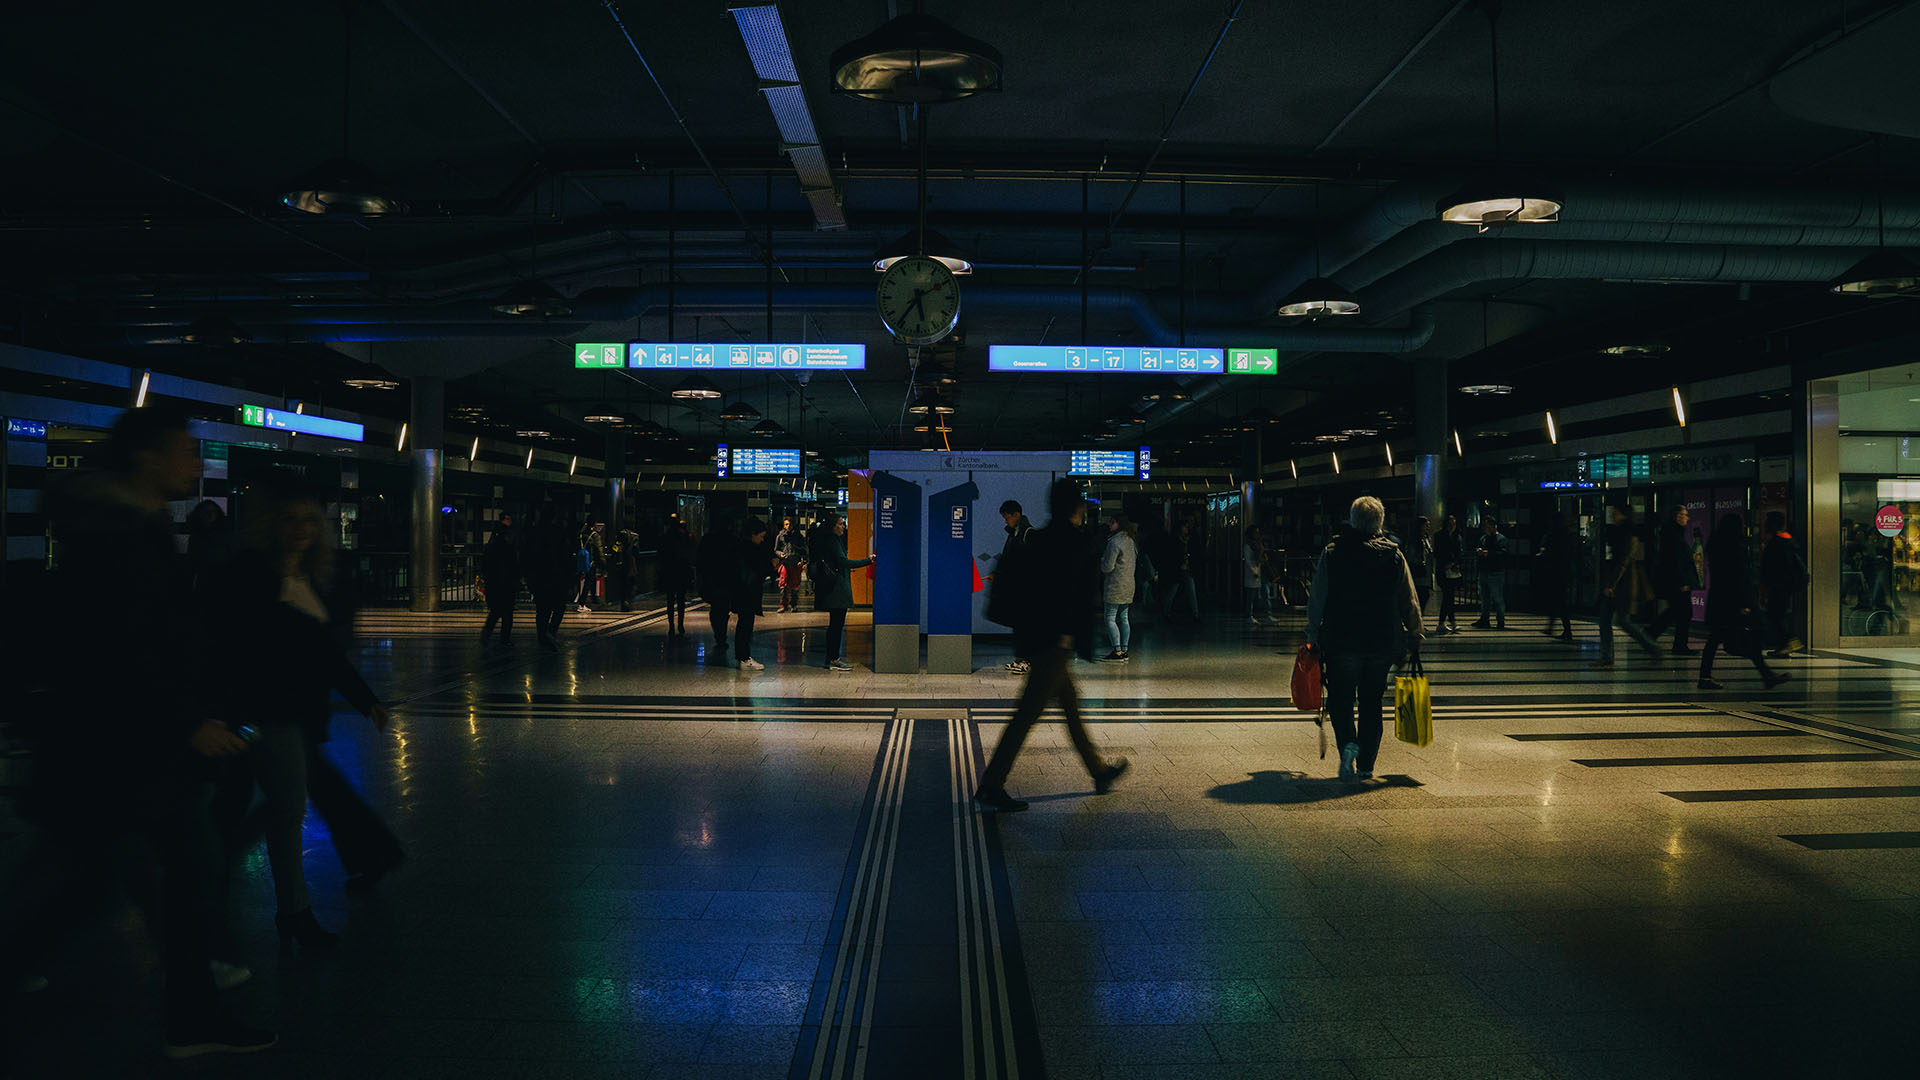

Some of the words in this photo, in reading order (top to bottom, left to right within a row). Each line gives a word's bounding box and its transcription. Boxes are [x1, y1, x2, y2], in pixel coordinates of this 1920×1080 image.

[658, 353, 672, 365] 41
[694, 353, 711, 365] 44
[1072, 356, 1081, 367] 3
[1107, 356, 1120, 367] 17
[1144, 357, 1157, 368] 21
[1180, 357, 1196, 369] 34
[1669, 456, 1699, 474] BODY
